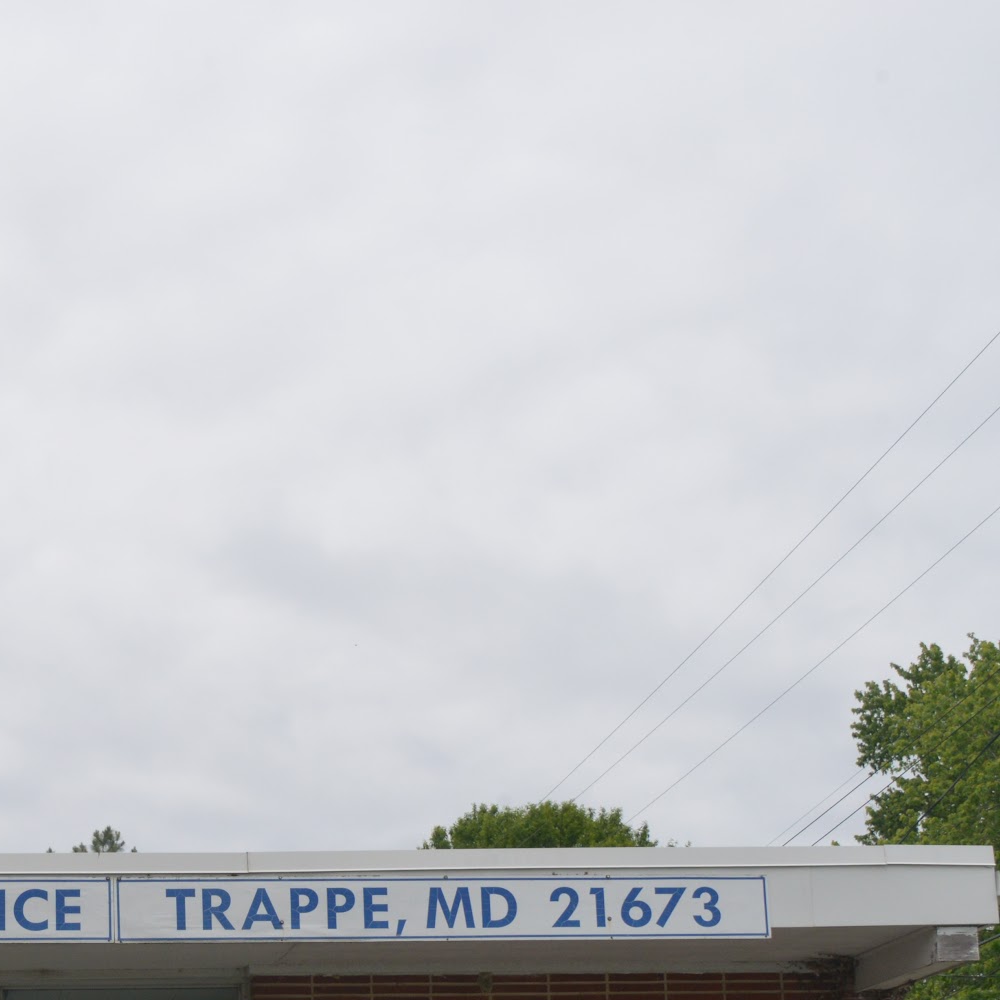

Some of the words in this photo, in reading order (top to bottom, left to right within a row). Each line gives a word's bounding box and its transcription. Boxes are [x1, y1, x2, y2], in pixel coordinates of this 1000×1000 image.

[165, 886, 408, 936] TRAPPE,
[426, 886, 518, 929] MD
[549, 886, 722, 929] 21673
